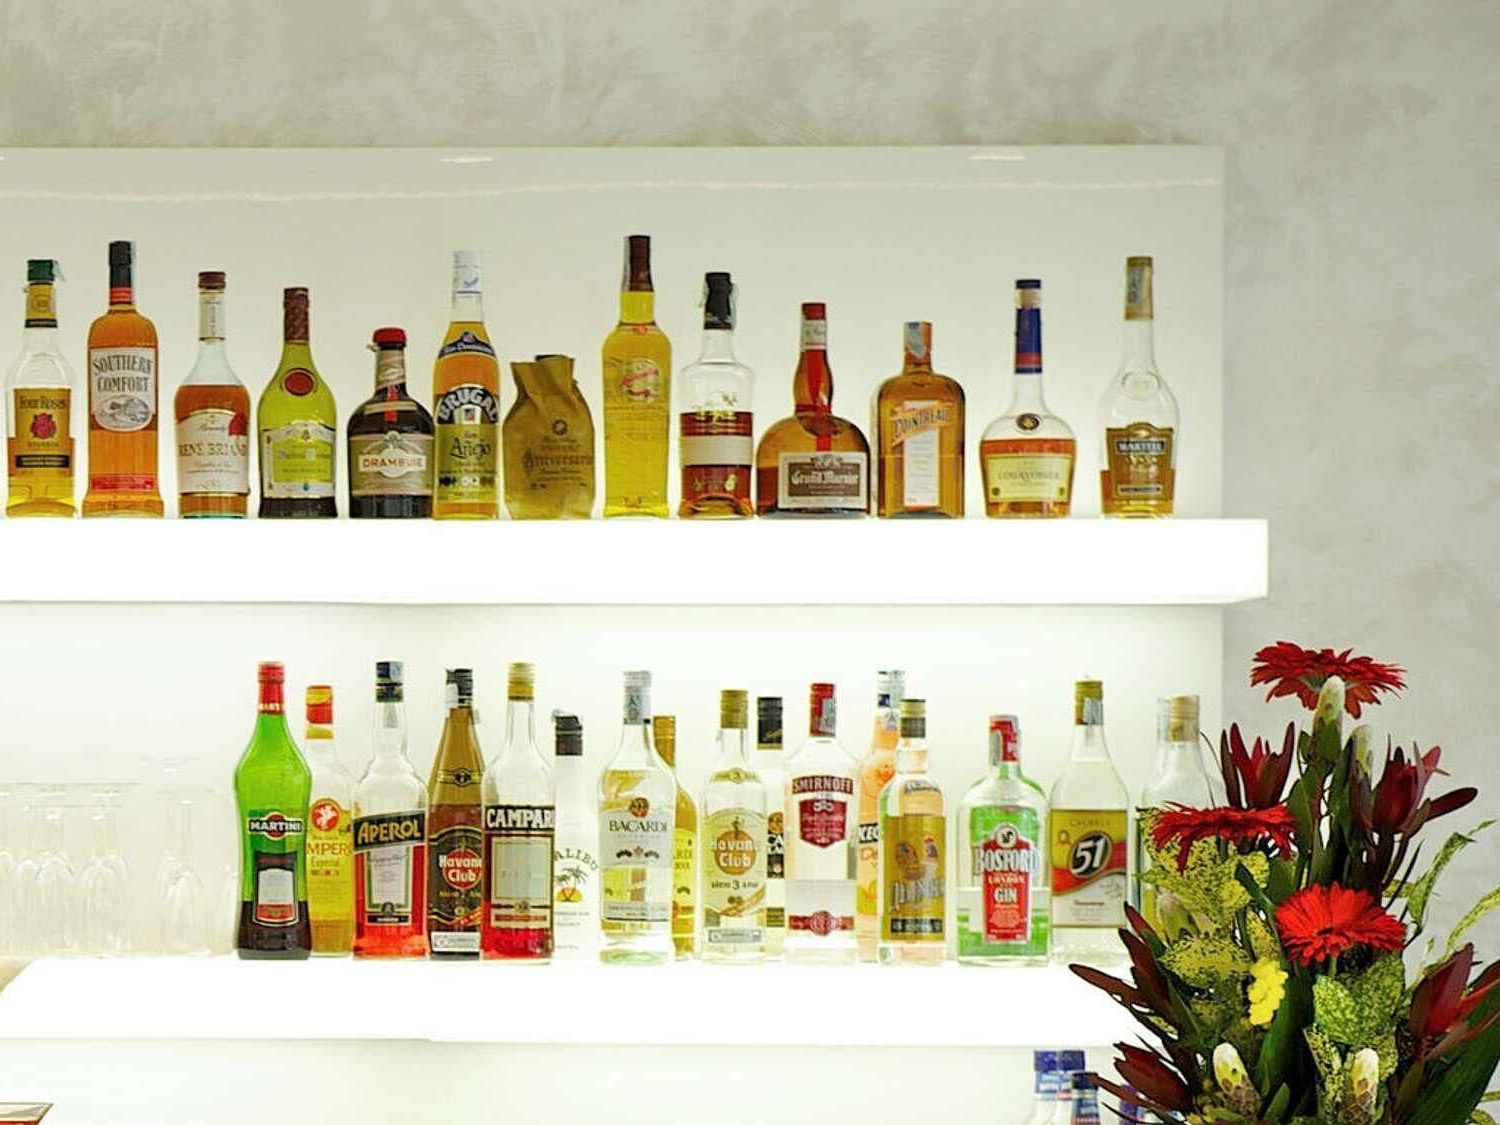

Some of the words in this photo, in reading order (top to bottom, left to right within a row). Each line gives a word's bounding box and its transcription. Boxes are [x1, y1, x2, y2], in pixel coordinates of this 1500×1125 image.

[97, 376, 149, 393] COMFORT
[363, 452, 426, 469] DRAMBUIE
[793, 776, 853, 794] SMIRNOFF
[250, 820, 302, 833] MARTINI
[358, 819, 422, 846] APEROL
[608, 819, 669, 833] BACARDI
[719, 854, 752, 871] Club
[1072, 837, 1107, 877] 51
[448, 868, 477, 882] Club
[732, 880, 741, 892] 3
[994, 886, 1017, 905] GIN
